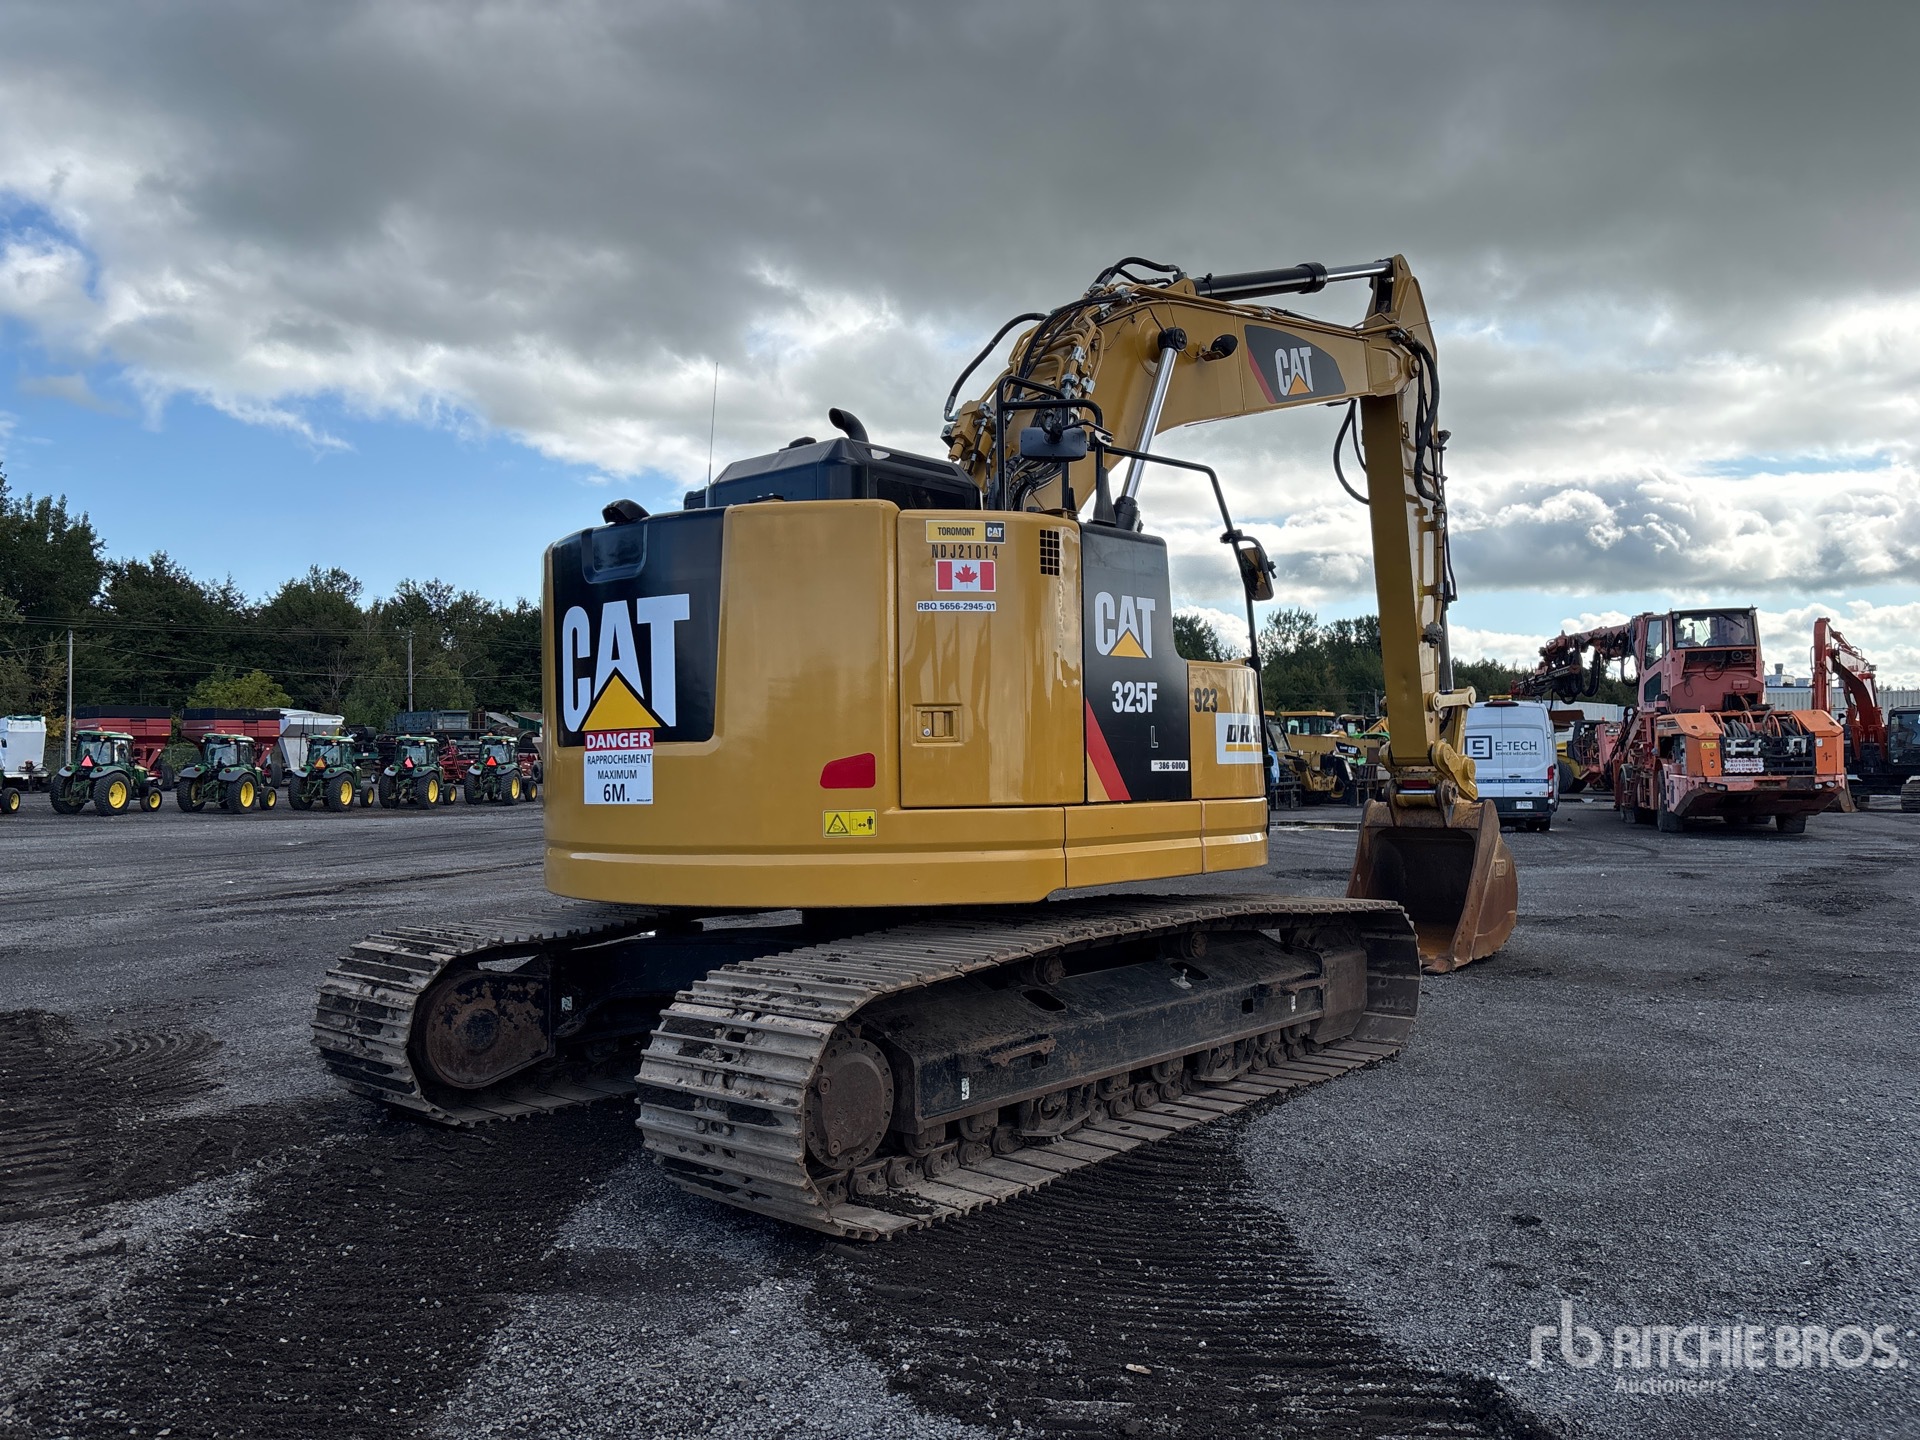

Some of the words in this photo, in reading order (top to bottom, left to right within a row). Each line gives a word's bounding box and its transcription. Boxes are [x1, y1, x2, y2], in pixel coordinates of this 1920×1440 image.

[1275, 346, 1314, 396] CAT
[938, 527, 975, 536] TOROMONT
[986, 526, 1003, 538] CAT
[917, 602, 938, 611] RBQ
[940, 602, 995, 611] 5656-2945-01
[1094, 591, 1156, 659] CAT
[562, 593, 690, 733] CAT
[1111, 680, 1158, 713] 325F
[1194, 687, 1218, 713] 923
[586, 732, 651, 749] DANGER
[1150, 725, 1159, 748] L
[1495, 741, 1537, 751] E-TECH
[587, 754, 652, 765] RAPPROCHEMENT
[597, 769, 638, 780] MAXIMUM
[603, 783, 630, 802] 6M.
